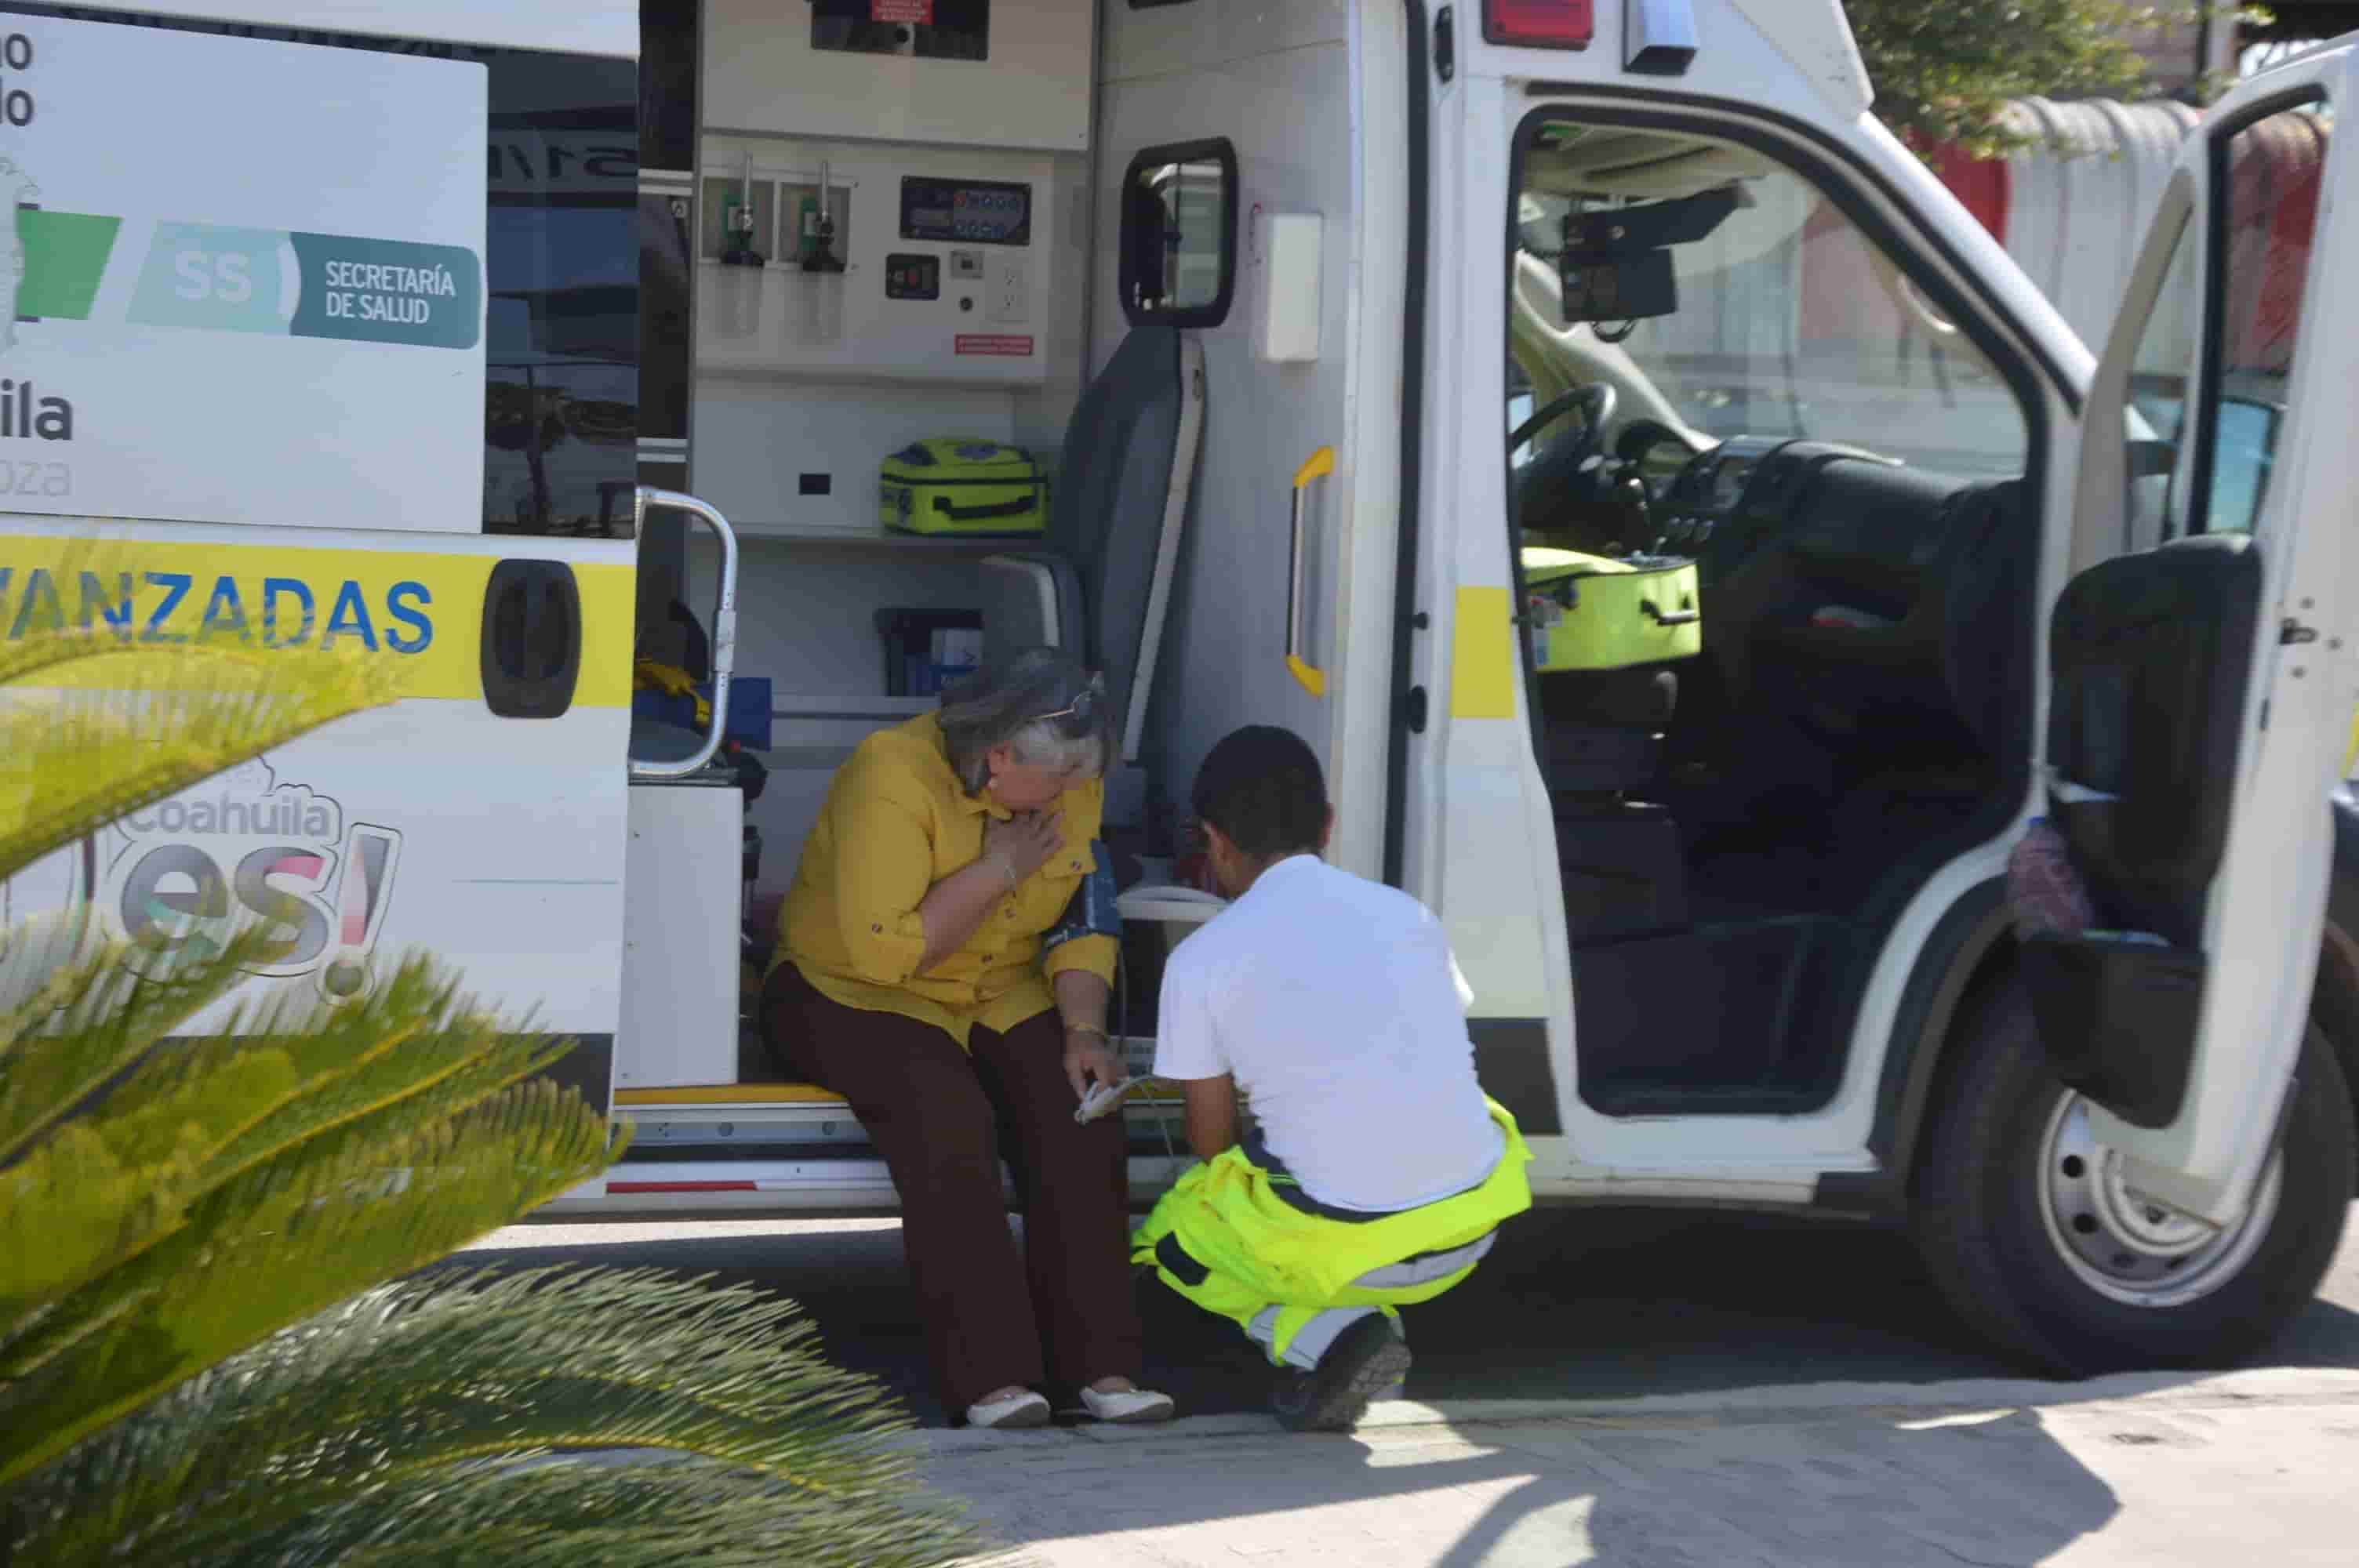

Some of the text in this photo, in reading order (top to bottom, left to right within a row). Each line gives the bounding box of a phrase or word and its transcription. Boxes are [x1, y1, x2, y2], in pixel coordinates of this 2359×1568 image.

[175, 250, 253, 303] SS
[325, 260, 456, 298] SECRETARÍA
[326, 292, 430, 325] DE SALUD
[0, 567, 433, 654] ANZADAS
